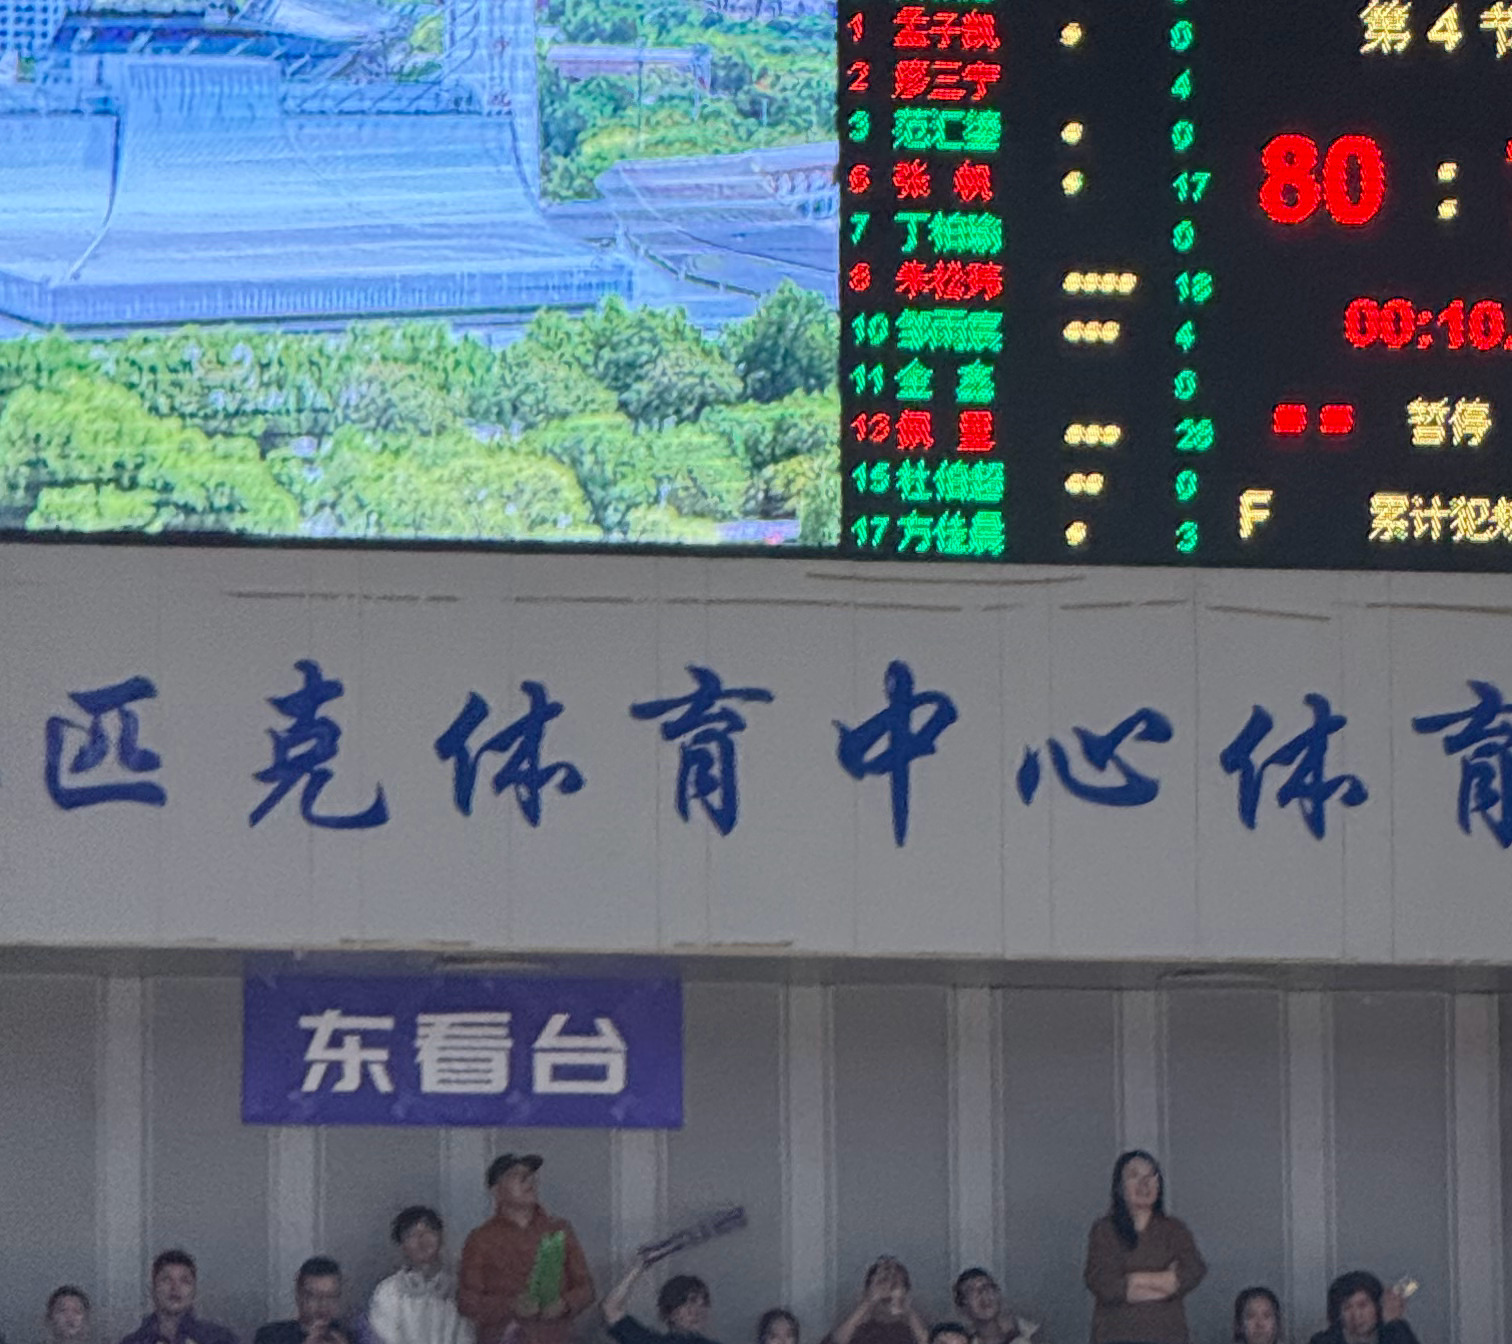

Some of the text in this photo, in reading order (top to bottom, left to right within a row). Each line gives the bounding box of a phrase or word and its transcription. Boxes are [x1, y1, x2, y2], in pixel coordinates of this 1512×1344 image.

[846, 12, 863, 43] 1
[1169, 20, 1193, 51] 0
[846, 61, 870, 91] 2
[1171, 68, 1192, 100] 4
[848, 110, 870, 142] 3
[1171, 120, 1194, 151] 0
[1172, 171, 1212, 203] 17
[1259, 133, 1387, 225] 80
[850, 213, 870, 245] 7
[1172, 220, 1195, 252] 0
[851, 312, 889, 346] 10
[1175, 320, 1196, 351] 4
[849, 363, 884, 395] 11
[1173, 369, 1197, 401] 0
[850, 412, 891, 443] 13
[1406, 396, 1493, 447] 暂停
[851, 461, 891, 494] 15
[1175, 469, 1198, 501] 0
[1239, 489, 1274, 539] F
[850, 515, 890, 547] 17
[1175, 521, 1199, 553] 3
[298, 1009, 628, 1095] 东看台
